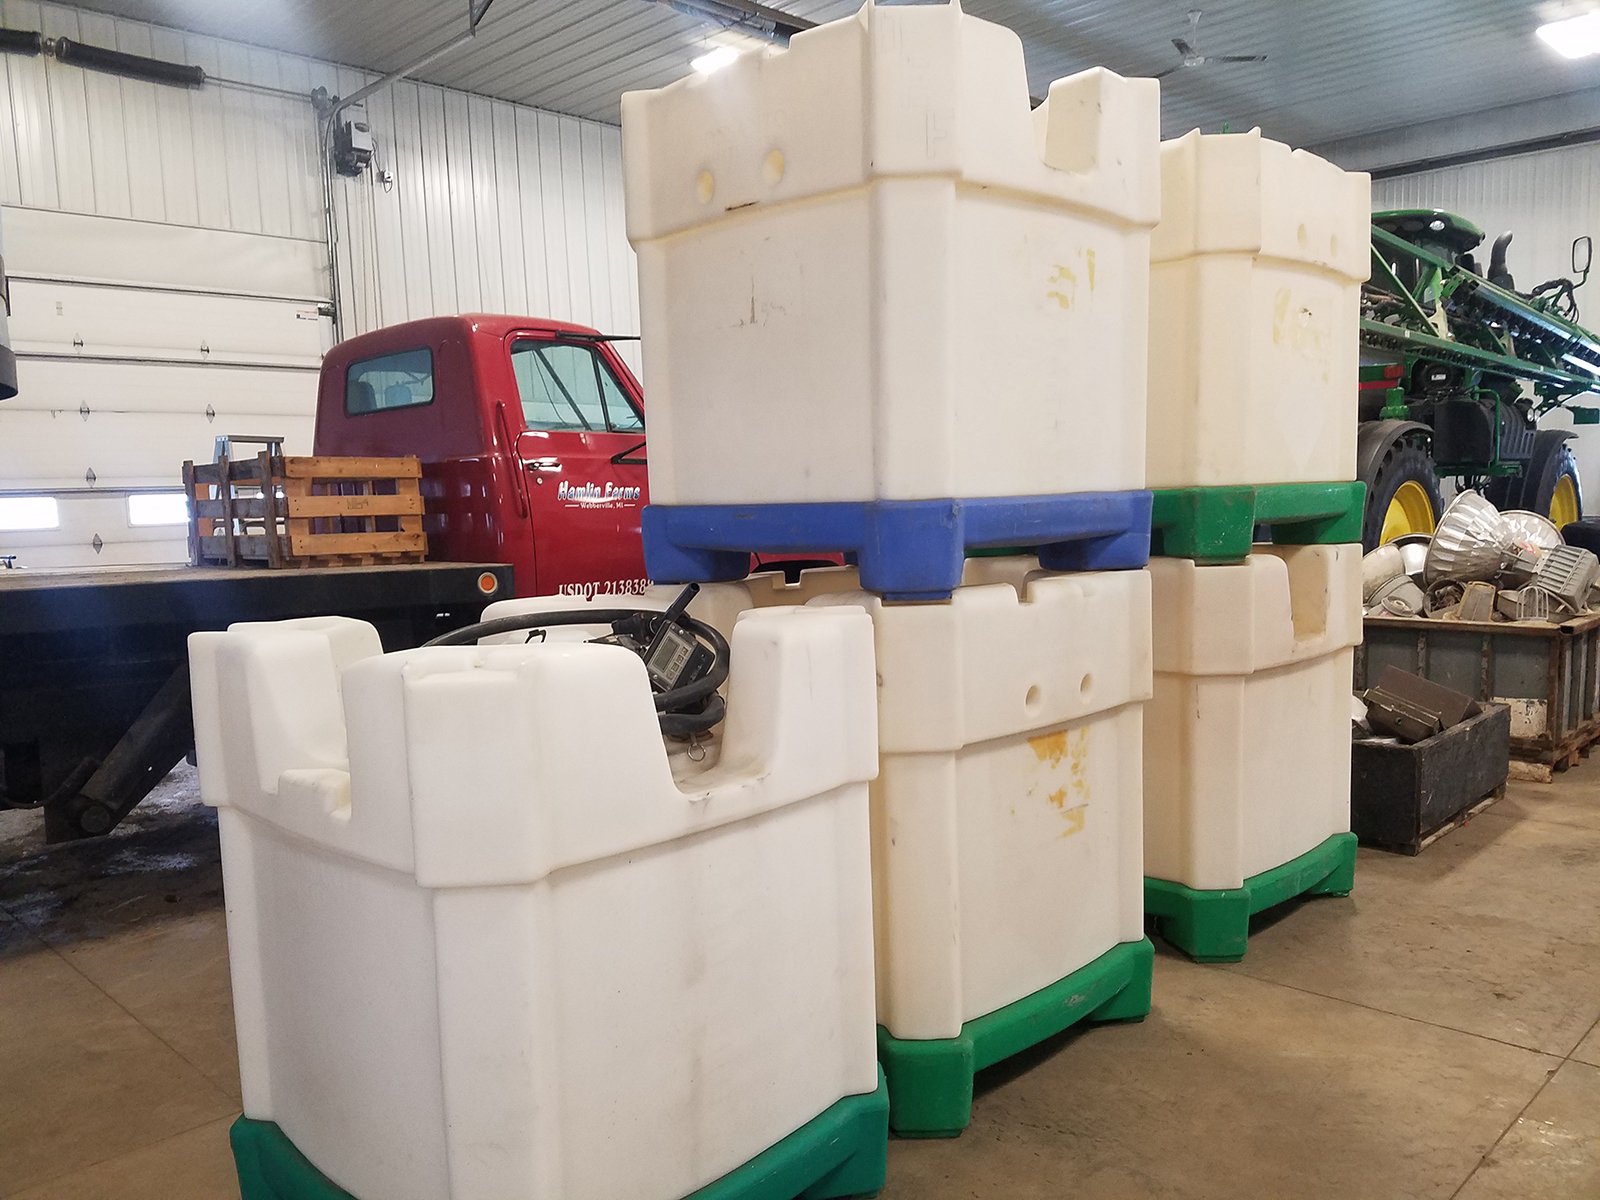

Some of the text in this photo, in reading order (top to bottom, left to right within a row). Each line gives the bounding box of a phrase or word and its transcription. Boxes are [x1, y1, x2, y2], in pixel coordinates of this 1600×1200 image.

[557, 480, 640, 501] Hamlin Farms
[559, 581, 600, 598] USDOT
